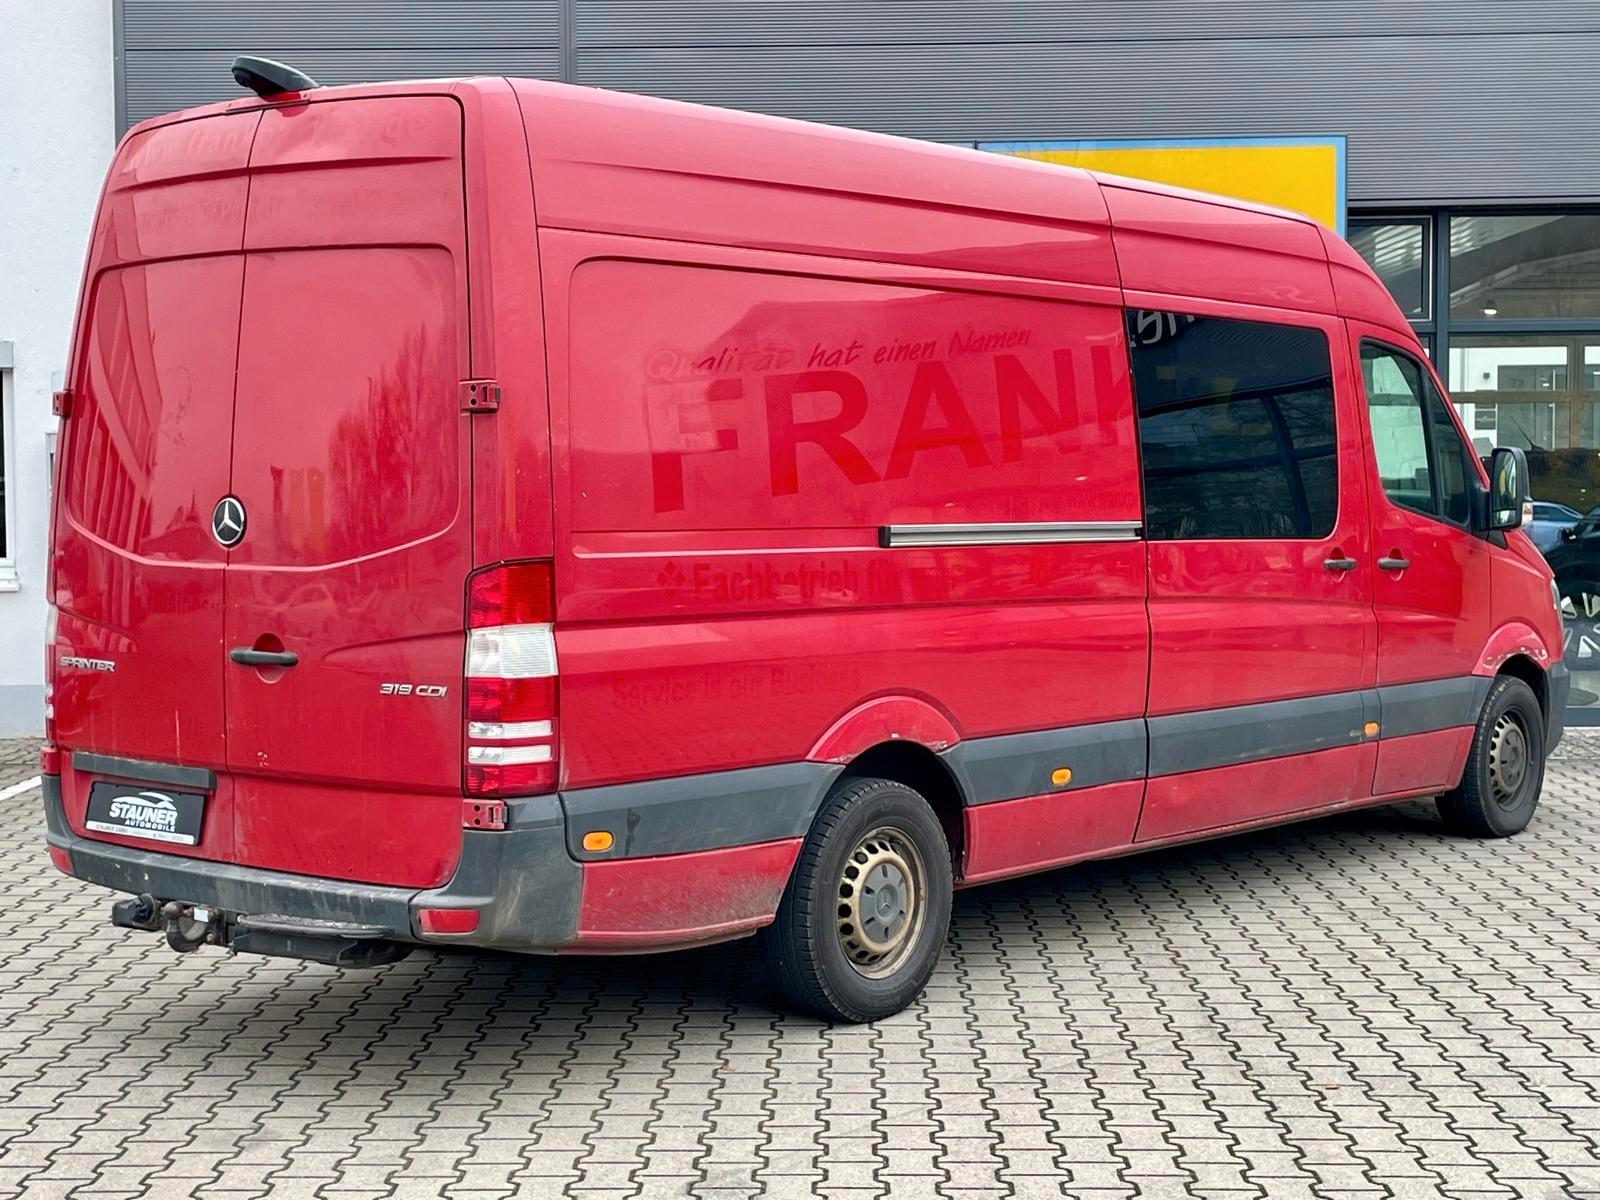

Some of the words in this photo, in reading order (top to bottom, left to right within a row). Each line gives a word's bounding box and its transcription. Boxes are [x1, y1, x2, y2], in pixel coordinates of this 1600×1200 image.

[806, 338, 862, 369] hat
[872, 336, 938, 365] einen
[947, 328, 1033, 356] Namen
[60, 656, 116, 672] SPRINTER
[380, 683, 413, 696] 319
[416, 685, 448, 697] CDI
[109, 802, 178, 825] STAUNER
[124, 819, 176, 832] AUTOMOBILE
